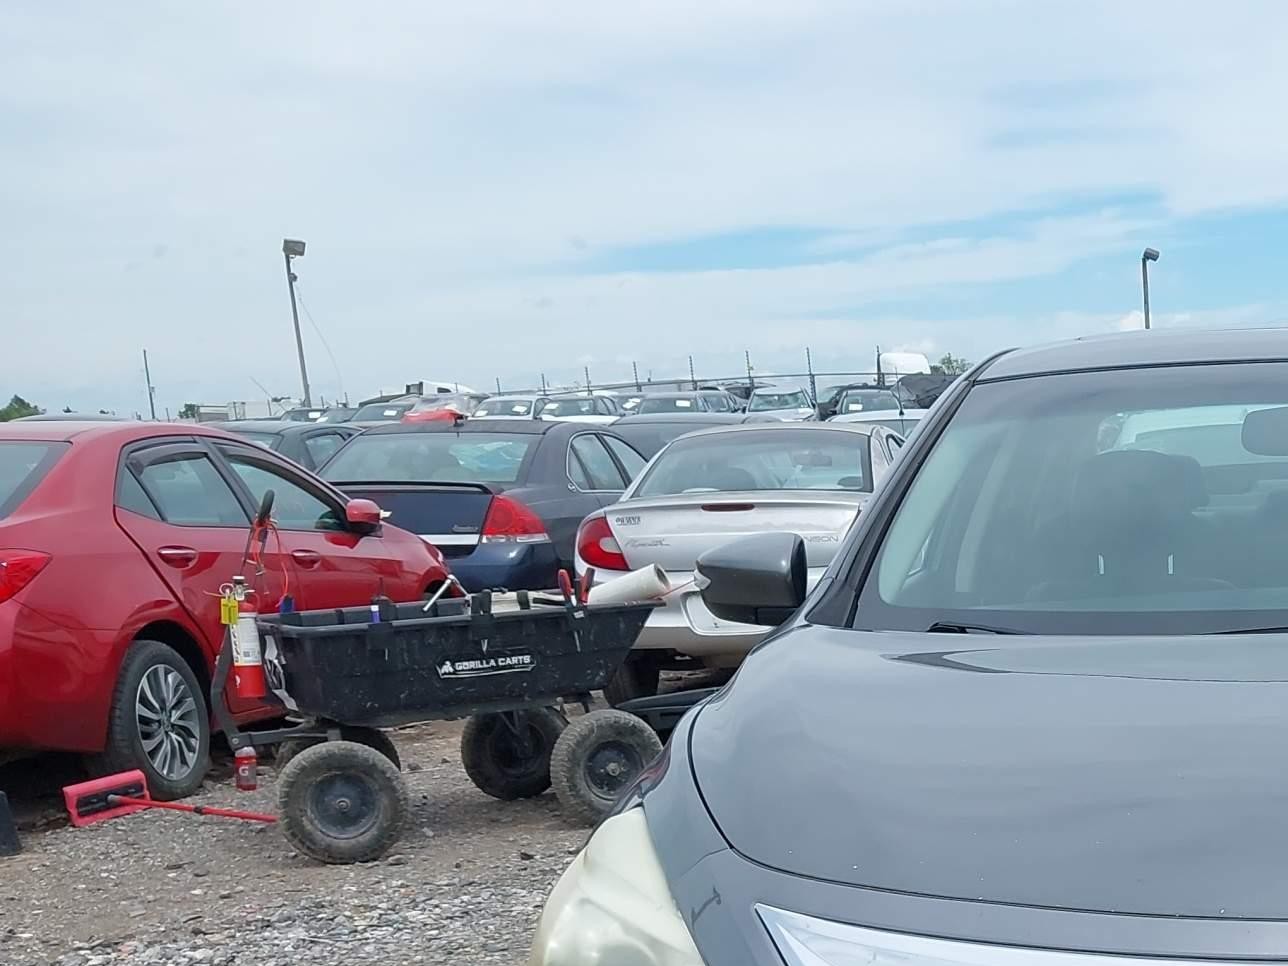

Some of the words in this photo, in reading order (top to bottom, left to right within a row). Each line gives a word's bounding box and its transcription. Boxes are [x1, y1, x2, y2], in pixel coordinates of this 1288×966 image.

[455, 660, 496, 671] GORILLA
[498, 655, 531, 666] CARTS
[239, 766, 249, 777] G
